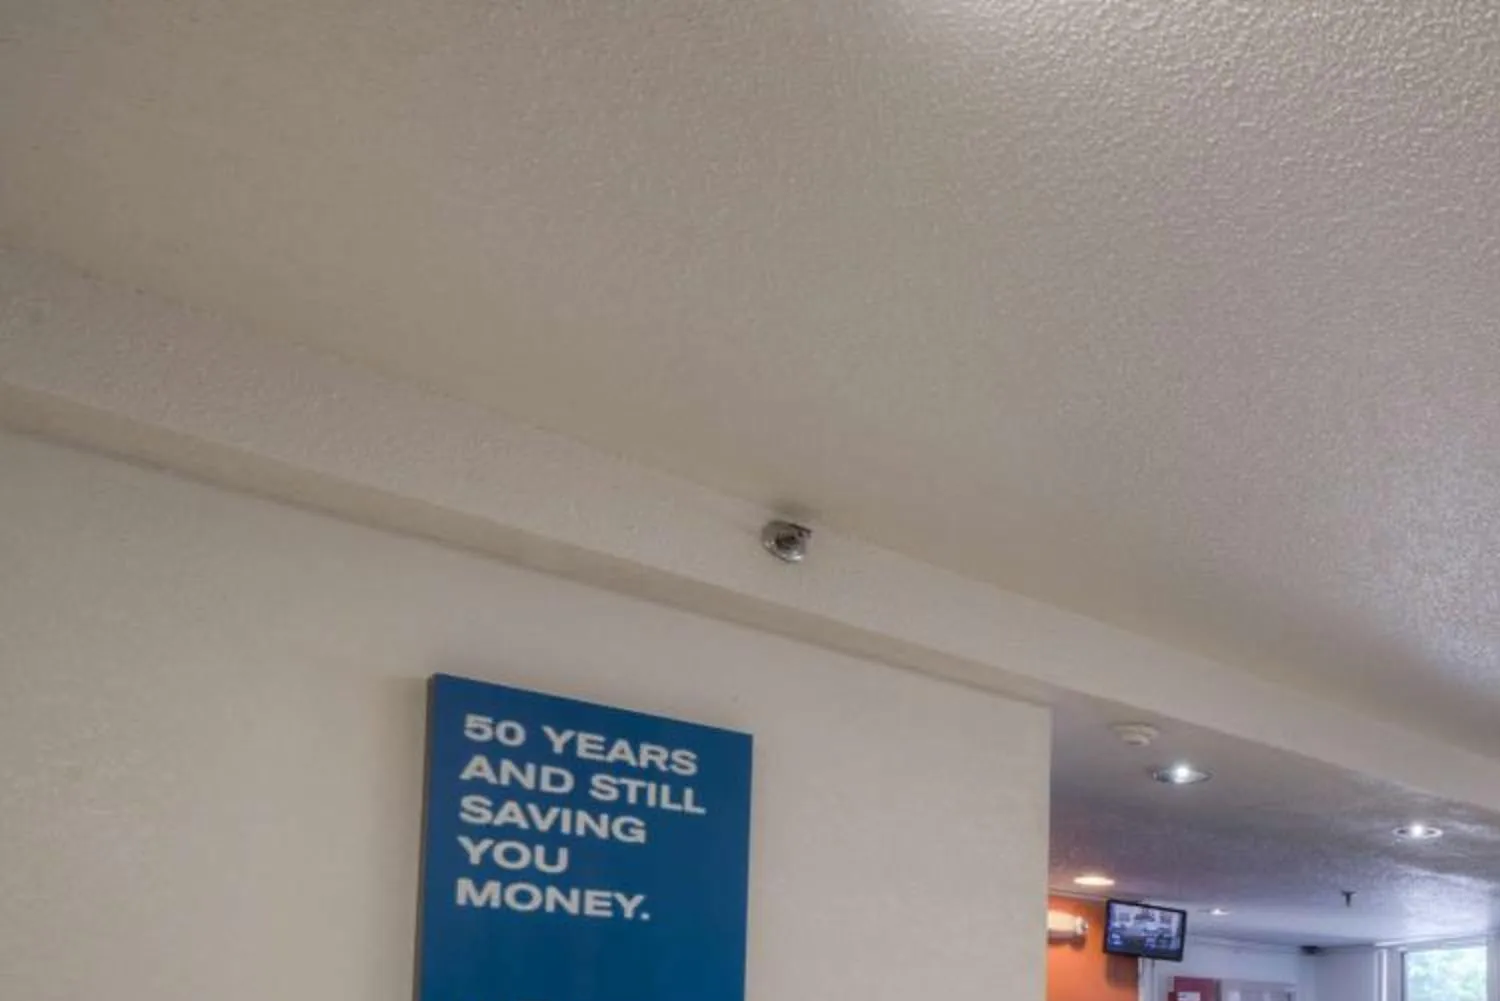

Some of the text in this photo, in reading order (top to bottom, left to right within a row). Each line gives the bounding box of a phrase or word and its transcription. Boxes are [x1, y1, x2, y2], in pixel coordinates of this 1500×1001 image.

[463, 713, 699, 776] 50 YEARS
[458, 755, 707, 815] AND STILL
[458, 795, 647, 844] SAVING
[456, 837, 569, 873] YOU
[455, 878, 651, 921] MONEY.
